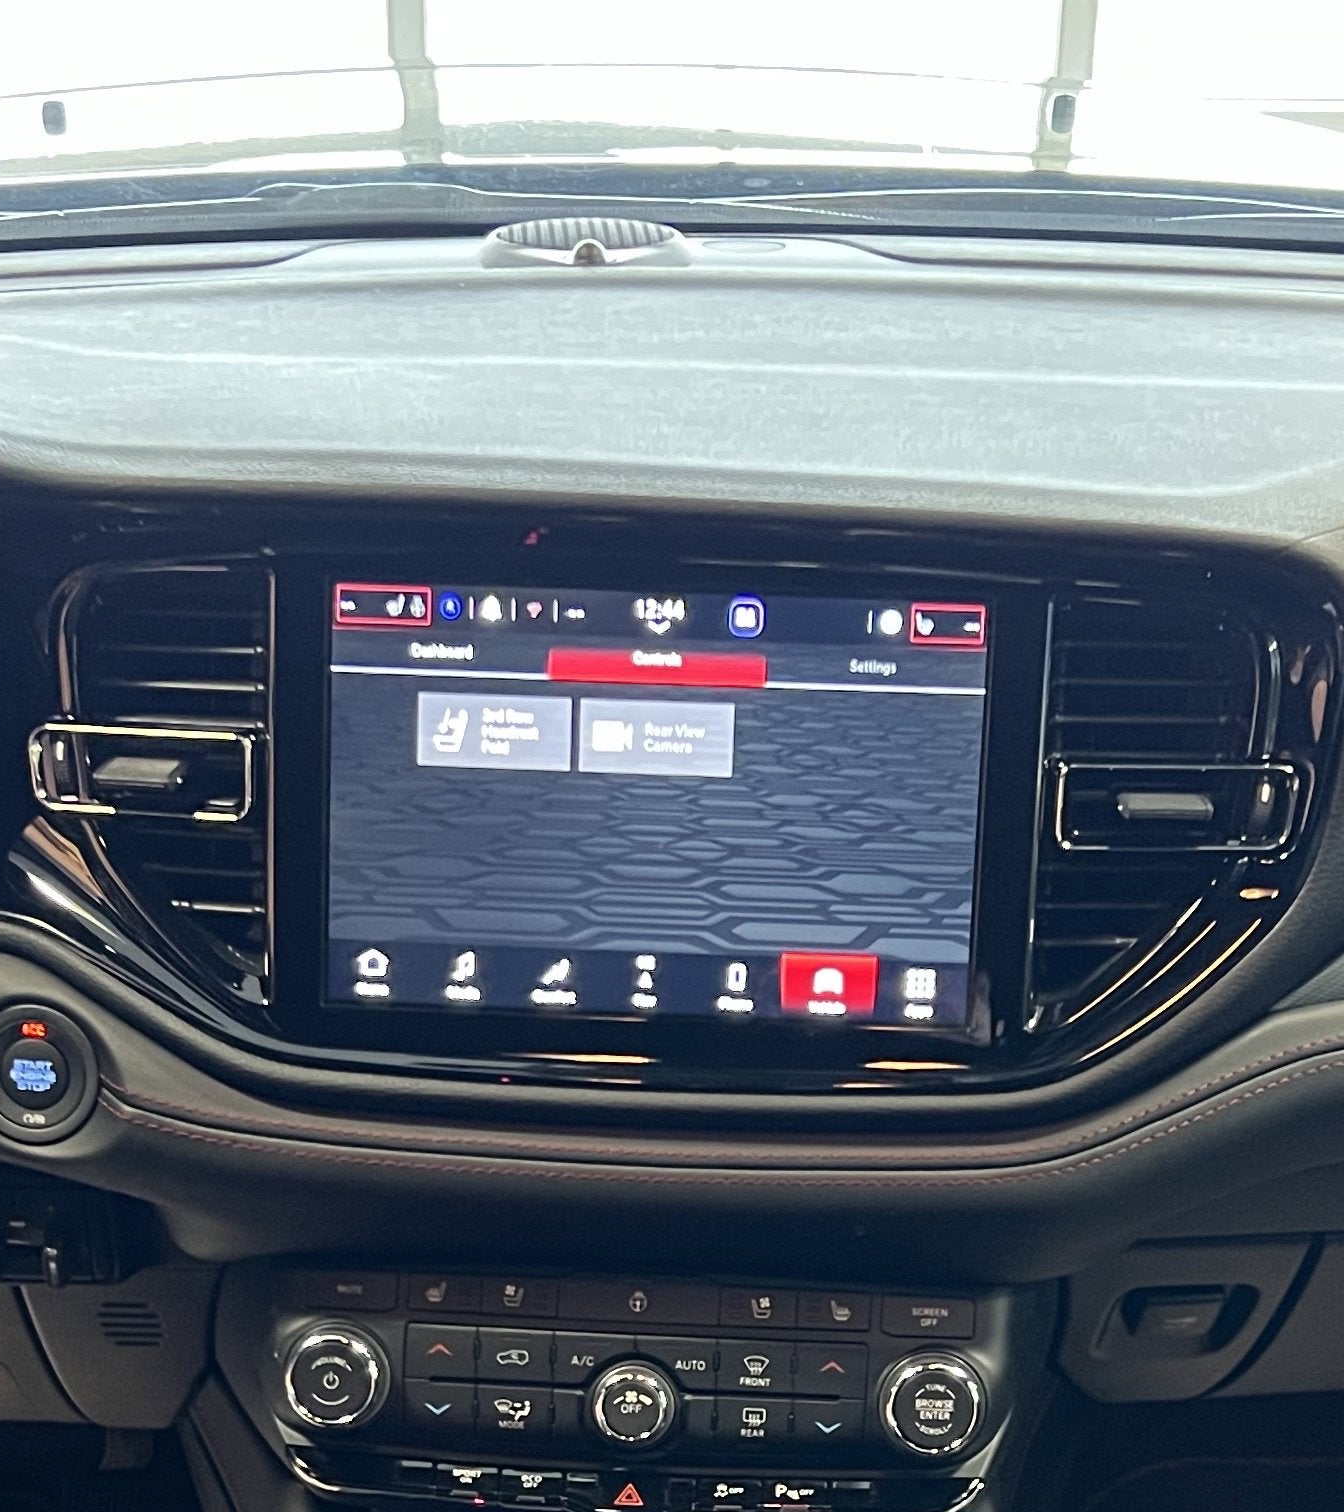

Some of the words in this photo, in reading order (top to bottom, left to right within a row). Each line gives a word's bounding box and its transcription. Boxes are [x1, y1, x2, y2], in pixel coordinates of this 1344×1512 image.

[849, 659, 897, 677] Settings
[644, 722, 673, 738] Rear
[675, 723, 706, 740] View
[644, 739, 693, 755] Camera
[13, 1059, 53, 1071] START
[912, 1307, 948, 1317] SCREEN
[570, 1355, 594, 1367] A/C
[675, 1360, 706, 1371] AUTO
[739, 1376, 771, 1387] FRONT
[620, 1404, 642, 1414] OFF
[915, 1399, 954, 1409] BROWSE
[919, 1410, 950, 1420] ENTER
[740, 1428, 765, 1438] REAR
